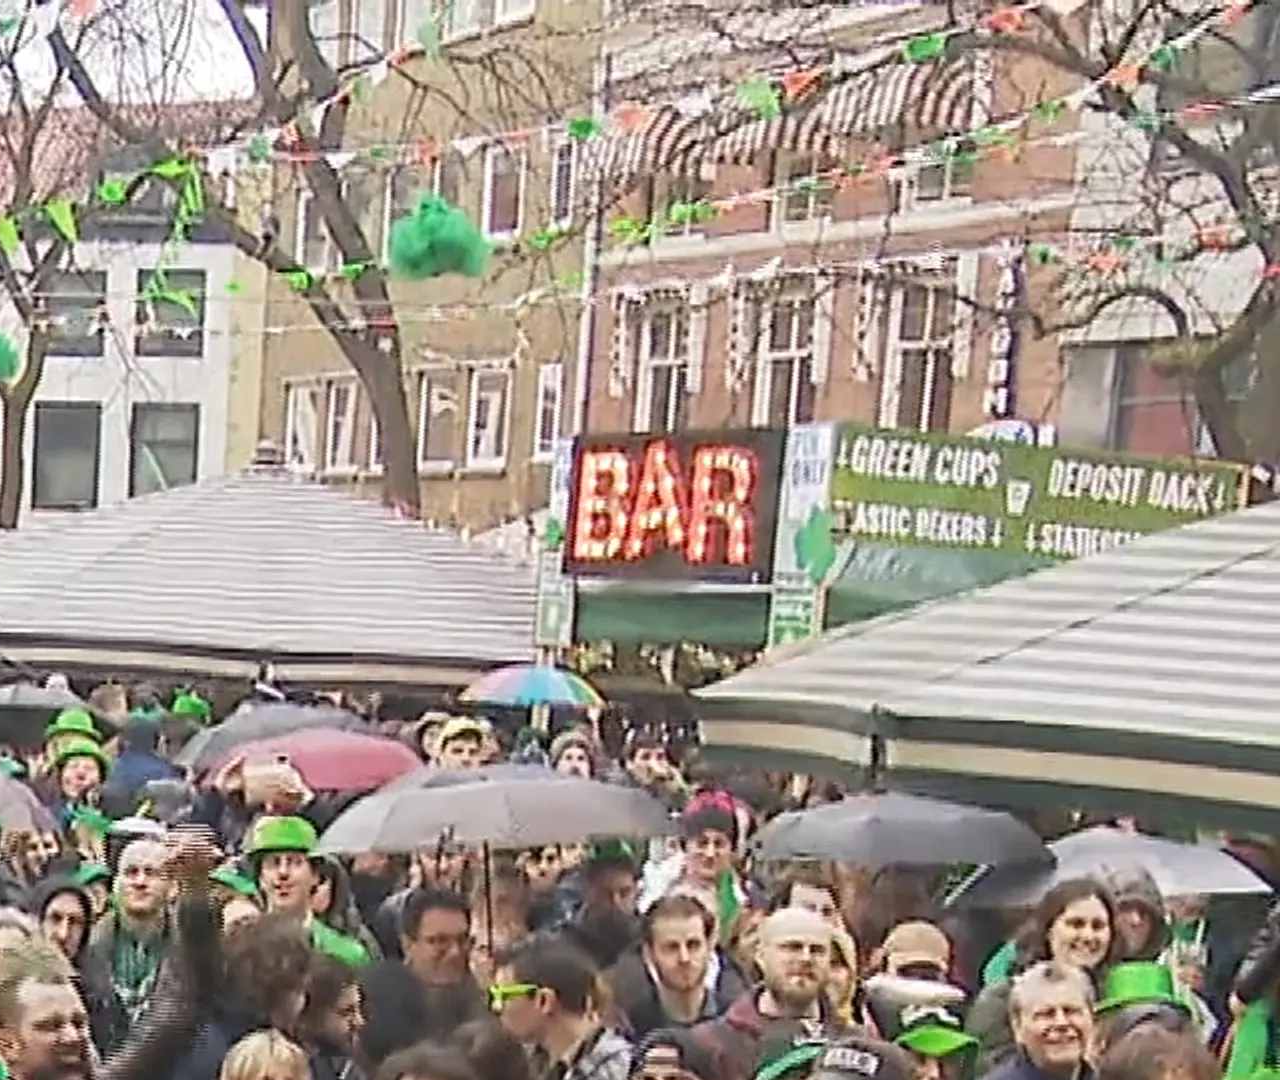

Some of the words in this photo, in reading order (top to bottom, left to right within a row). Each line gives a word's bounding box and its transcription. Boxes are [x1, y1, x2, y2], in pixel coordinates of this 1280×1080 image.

[573, 437, 759, 565] BAR
[851, 434, 930, 482] GREEN
[934, 446, 1001, 488] CUPS
[1048, 459, 1145, 507] DEPOSIT
[1040, 523, 1142, 557] STATIEG
